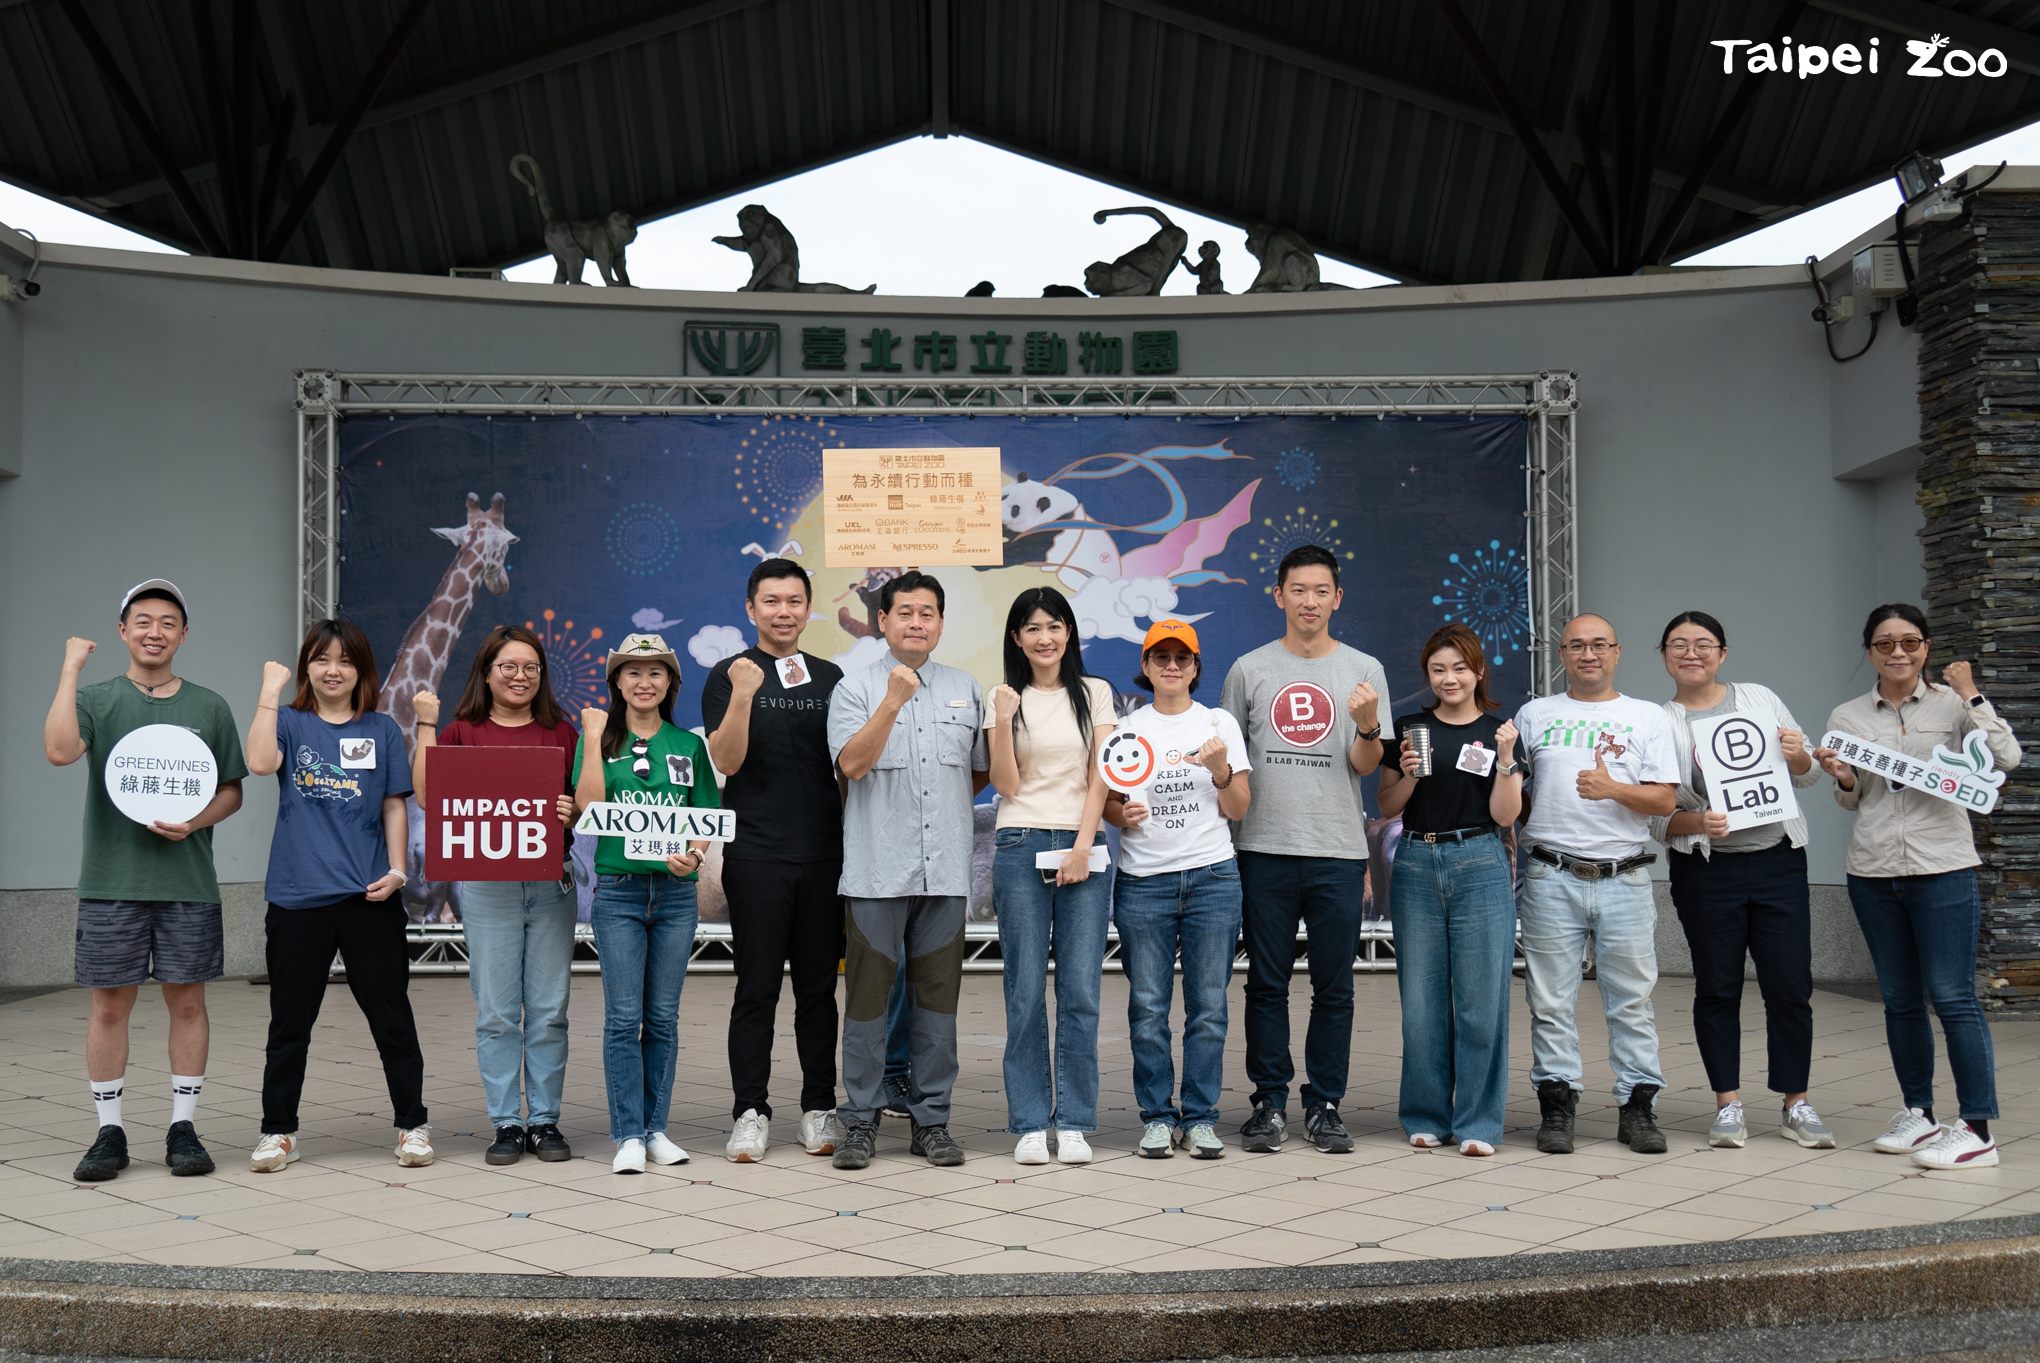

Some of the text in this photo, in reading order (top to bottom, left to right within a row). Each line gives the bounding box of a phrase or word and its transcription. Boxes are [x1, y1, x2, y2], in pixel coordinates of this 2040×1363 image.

[802, 325, 1178, 374] 臺北市立動物園
[852, 472, 974, 489] 為永續行動而種
[892, 543, 939, 552] NESPRESSO
[760, 697, 823, 710] EVOPURE
[1289, 692, 1315, 721] B
[1281, 722, 1326, 733] the change
[1724, 728, 1753, 762] B
[114, 756, 210, 773] GREENVINES
[1275, 757, 1292, 765] LAB
[1295, 758, 1331, 768] TAIWAN
[1826, 735, 1925, 782] 環境友善種子
[1157, 768, 1191, 779] KEEP
[120, 774, 201, 797] 綠藤生機
[1154, 781, 1195, 794] CALM
[1722, 781, 1779, 812] Lab
[442, 798, 548, 817] IMPACT
[1151, 802, 1199, 816] DREAM
[1753, 807, 1783, 818] Taiwan
[581, 807, 731, 838] AROMASE
[1165, 818, 1185, 829] ON
[442, 821, 547, 860] HUB
[630, 838, 681, 856] 艾瑪絲
